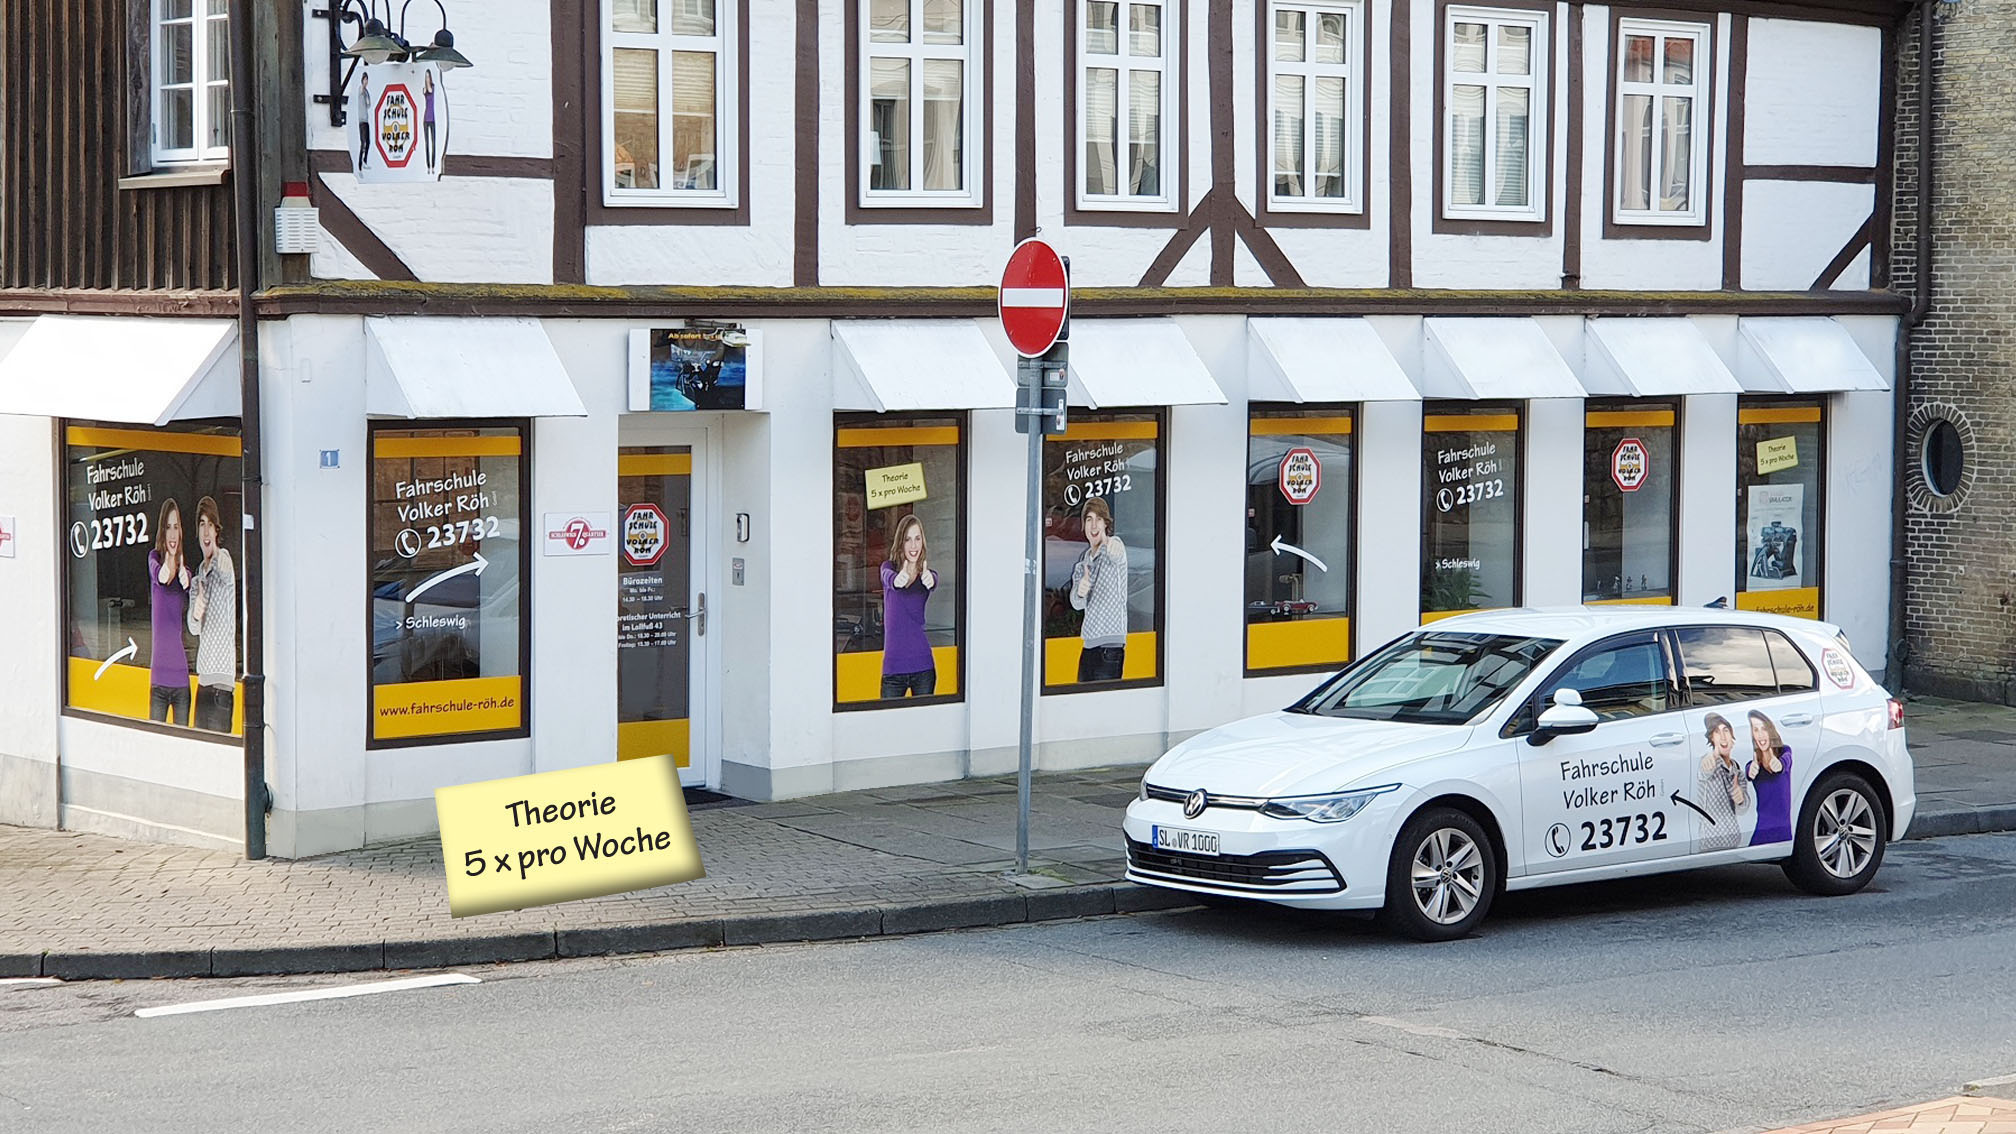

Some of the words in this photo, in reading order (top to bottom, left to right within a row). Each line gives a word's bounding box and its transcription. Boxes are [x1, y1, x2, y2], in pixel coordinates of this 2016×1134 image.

[386, 94, 405, 106] FAHR
[383, 107, 408, 119] SCHULE
[382, 131, 410, 141] VOLKER
[1065, 441, 1124, 464] Fahrschule
[1437, 441, 1496, 465] Fahrschule
[86, 457, 144, 485] Fahrschule
[882, 472, 908, 483] Theorie
[1066, 465, 1102, 481] Volker
[1103, 459, 1125, 474] Röh
[1438, 466, 1474, 484] Volker
[1476, 459, 1497, 476] Röh
[395, 469, 487, 499] Fahrschule
[871, 489, 877, 498] 5
[884, 489, 896, 499] pro
[897, 484, 920, 494] Woche
[1084, 474, 1132, 499] 23732
[1456, 478, 1504, 505] 23732
[88, 490, 123, 511] Volker
[124, 483, 146, 505] Röh
[397, 501, 453, 522] Volker
[456, 492, 489, 512] Röh
[629, 521, 657, 530] SCHULE
[632, 512, 654, 520] FAHR
[90, 512, 149, 550] 23732
[426, 516, 500, 549] 23732
[1441, 558, 1480, 570] Schleswig
[623, 576, 663, 585] Bürozeiten
[405, 614, 466, 629] Schleswig
[648, 611, 681, 620] Unterricht
[380, 696, 515, 717] www.fahrschule-röh.de
[1560, 751, 1654, 781] Fahrschule
[1563, 786, 1618, 809] Volker
[1623, 779, 1656, 801] Röh
[1159, 829, 1170, 847] SL
[1177, 832, 1190, 850] VR
[1192, 833, 1217, 853] 1000
[1581, 811, 1667, 852] 23732
